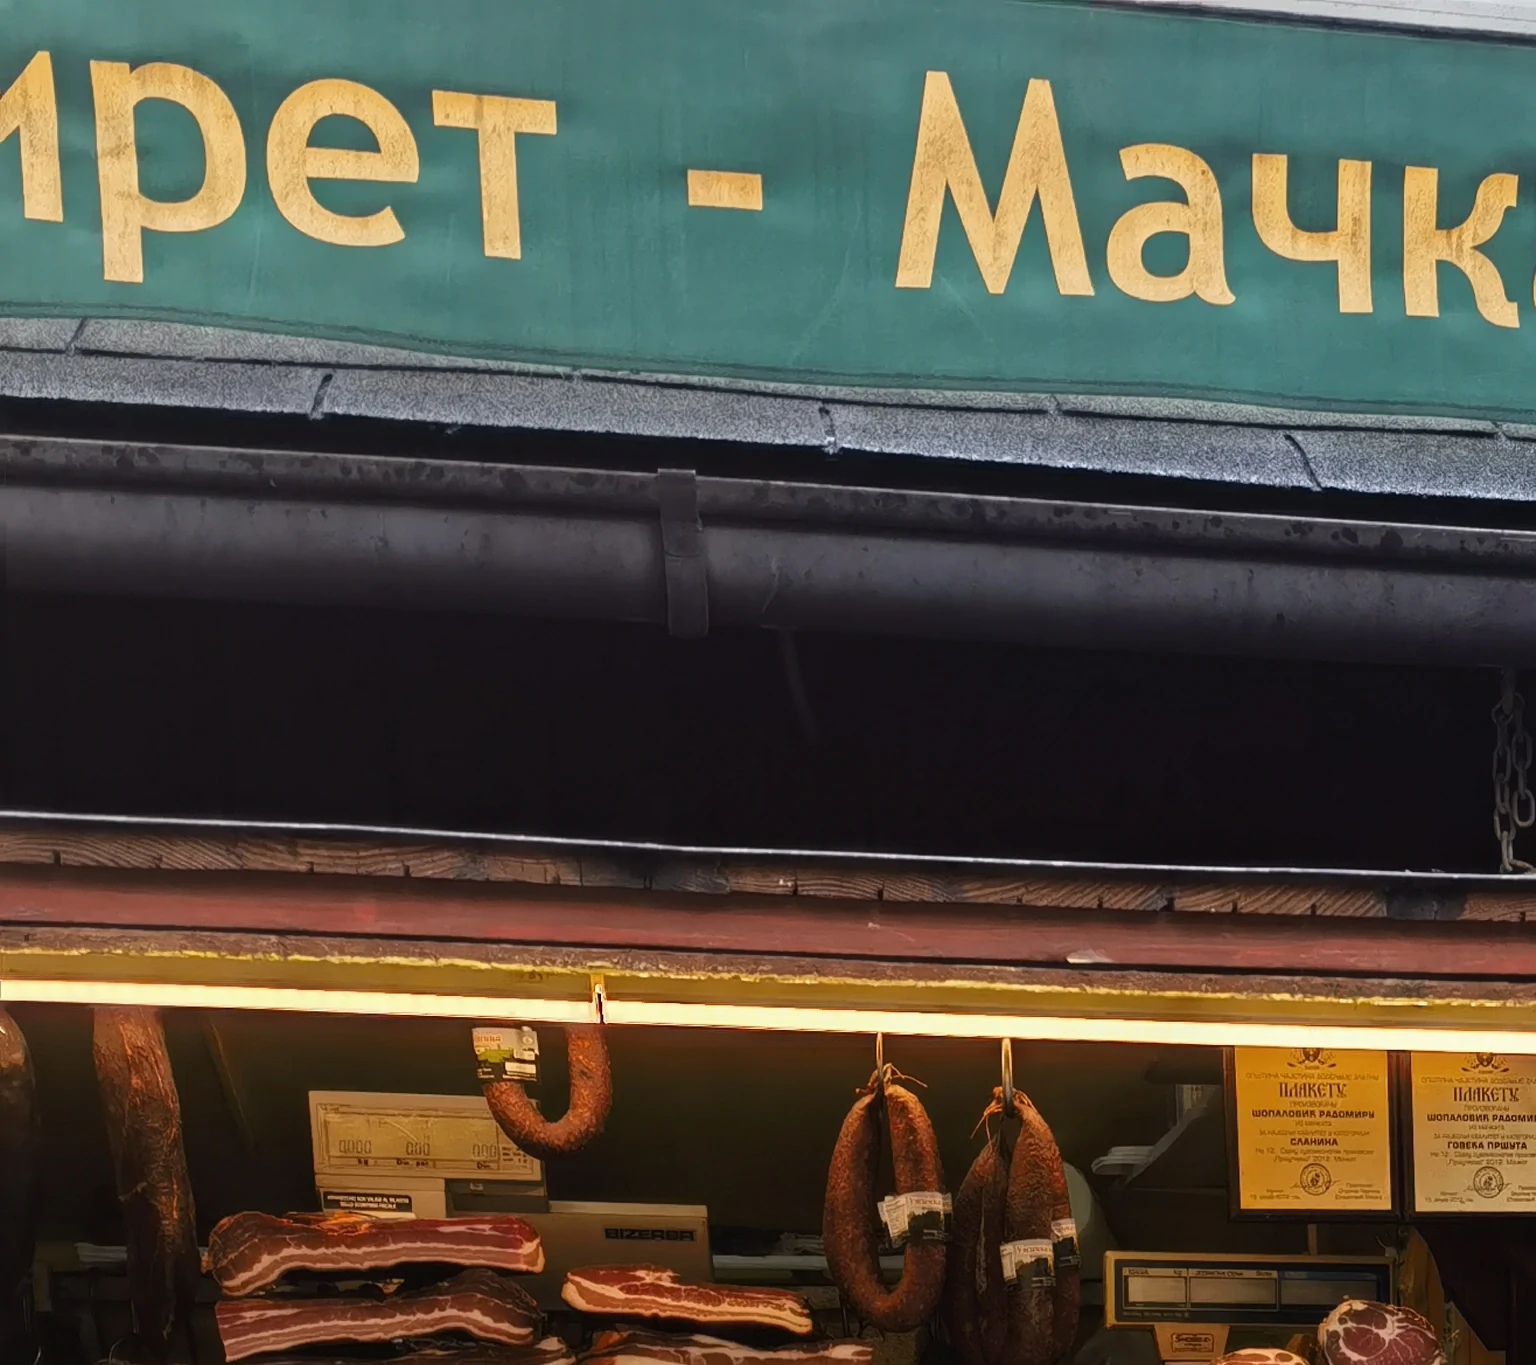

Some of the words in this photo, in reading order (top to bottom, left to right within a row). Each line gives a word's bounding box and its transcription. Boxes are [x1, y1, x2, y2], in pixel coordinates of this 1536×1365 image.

[687, 168, 763, 211] -
[1290, 1138, 1338, 1146] СЛАНИНА
[1487, 1141, 1528, 1150] ПРШУТА
